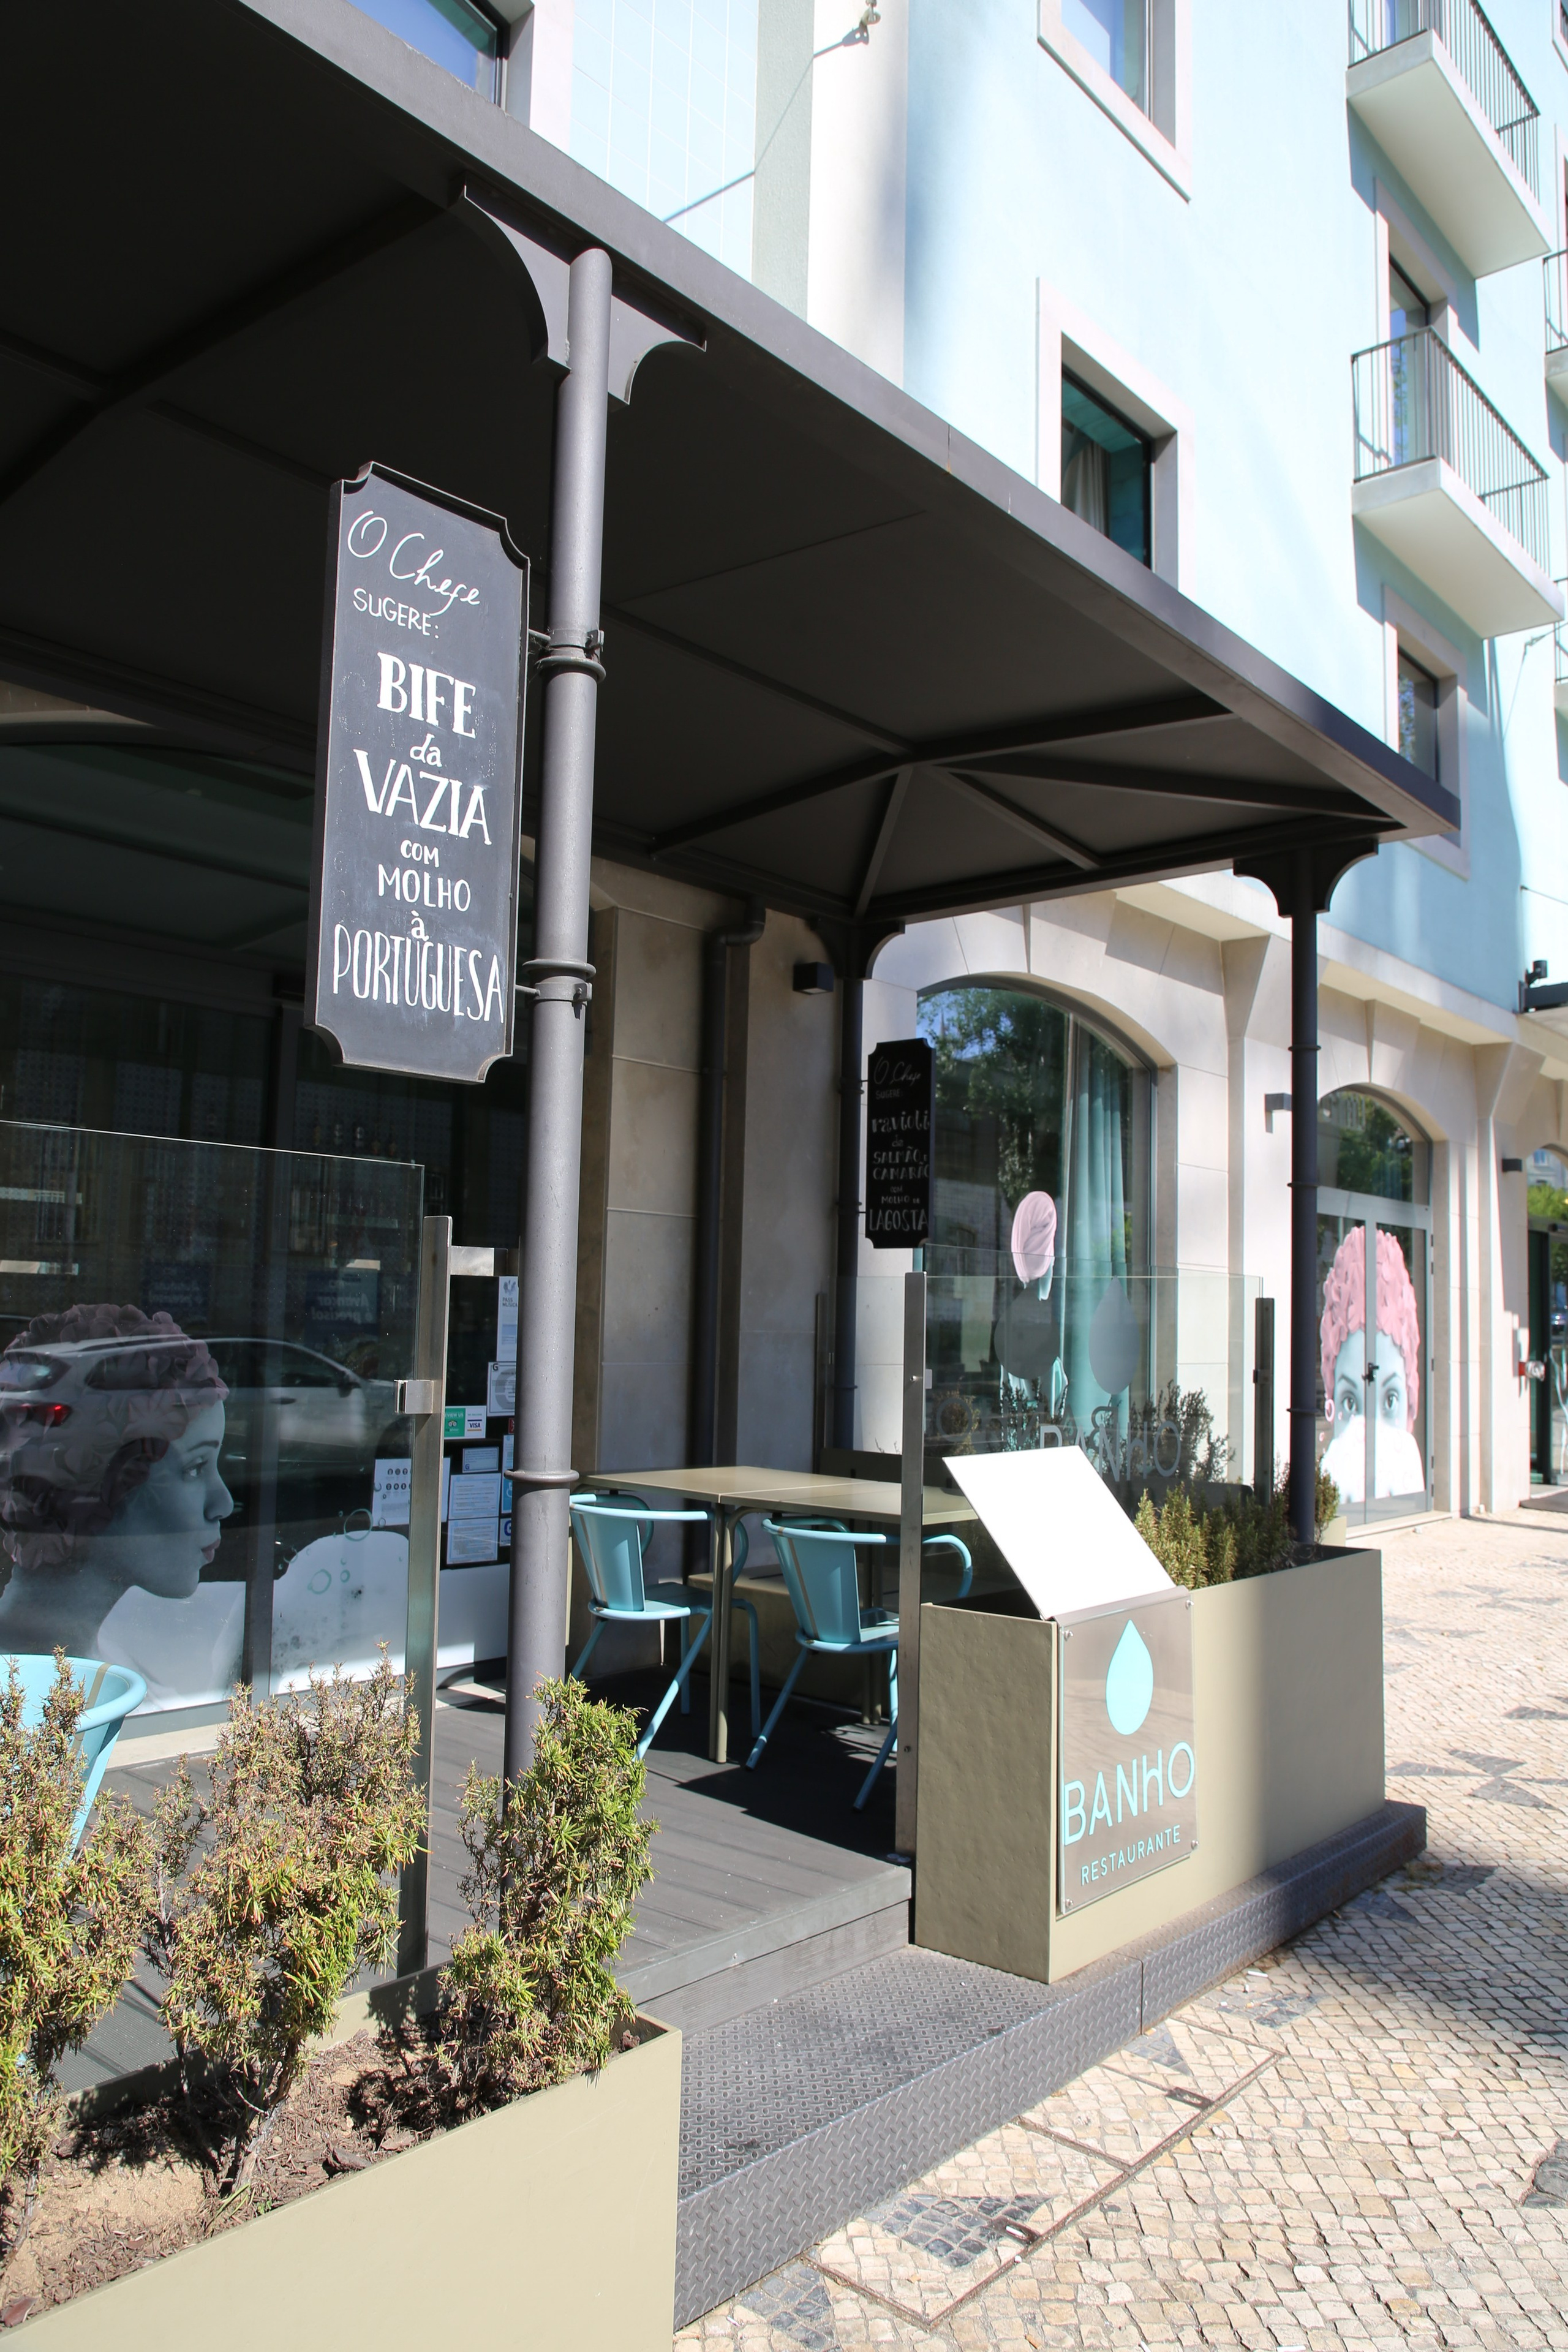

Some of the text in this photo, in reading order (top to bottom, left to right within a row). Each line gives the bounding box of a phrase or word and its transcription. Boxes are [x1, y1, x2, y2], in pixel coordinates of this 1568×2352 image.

[347, 510, 481, 617] O Chefe
[352, 588, 440, 639] SUGERE:
[377, 651, 477, 739] BIFE
[409, 734, 442, 767] da
[353, 749, 492, 845] VAZIA
[378, 864, 471, 912] MOLHO
[411, 910, 429, 941] à
[333, 924, 505, 1023] PORTUGUESA
[872, 1110, 930, 1133] ravioli
[872, 1145, 919, 1164] SALMÃO
[869, 1208, 929, 1231] LAGOSTA
[881, 1195, 910, 1204] MOLHO
[1063, 1741, 1196, 1846] BANHO
[1080, 1825, 1181, 1886] RESTAURANTE
